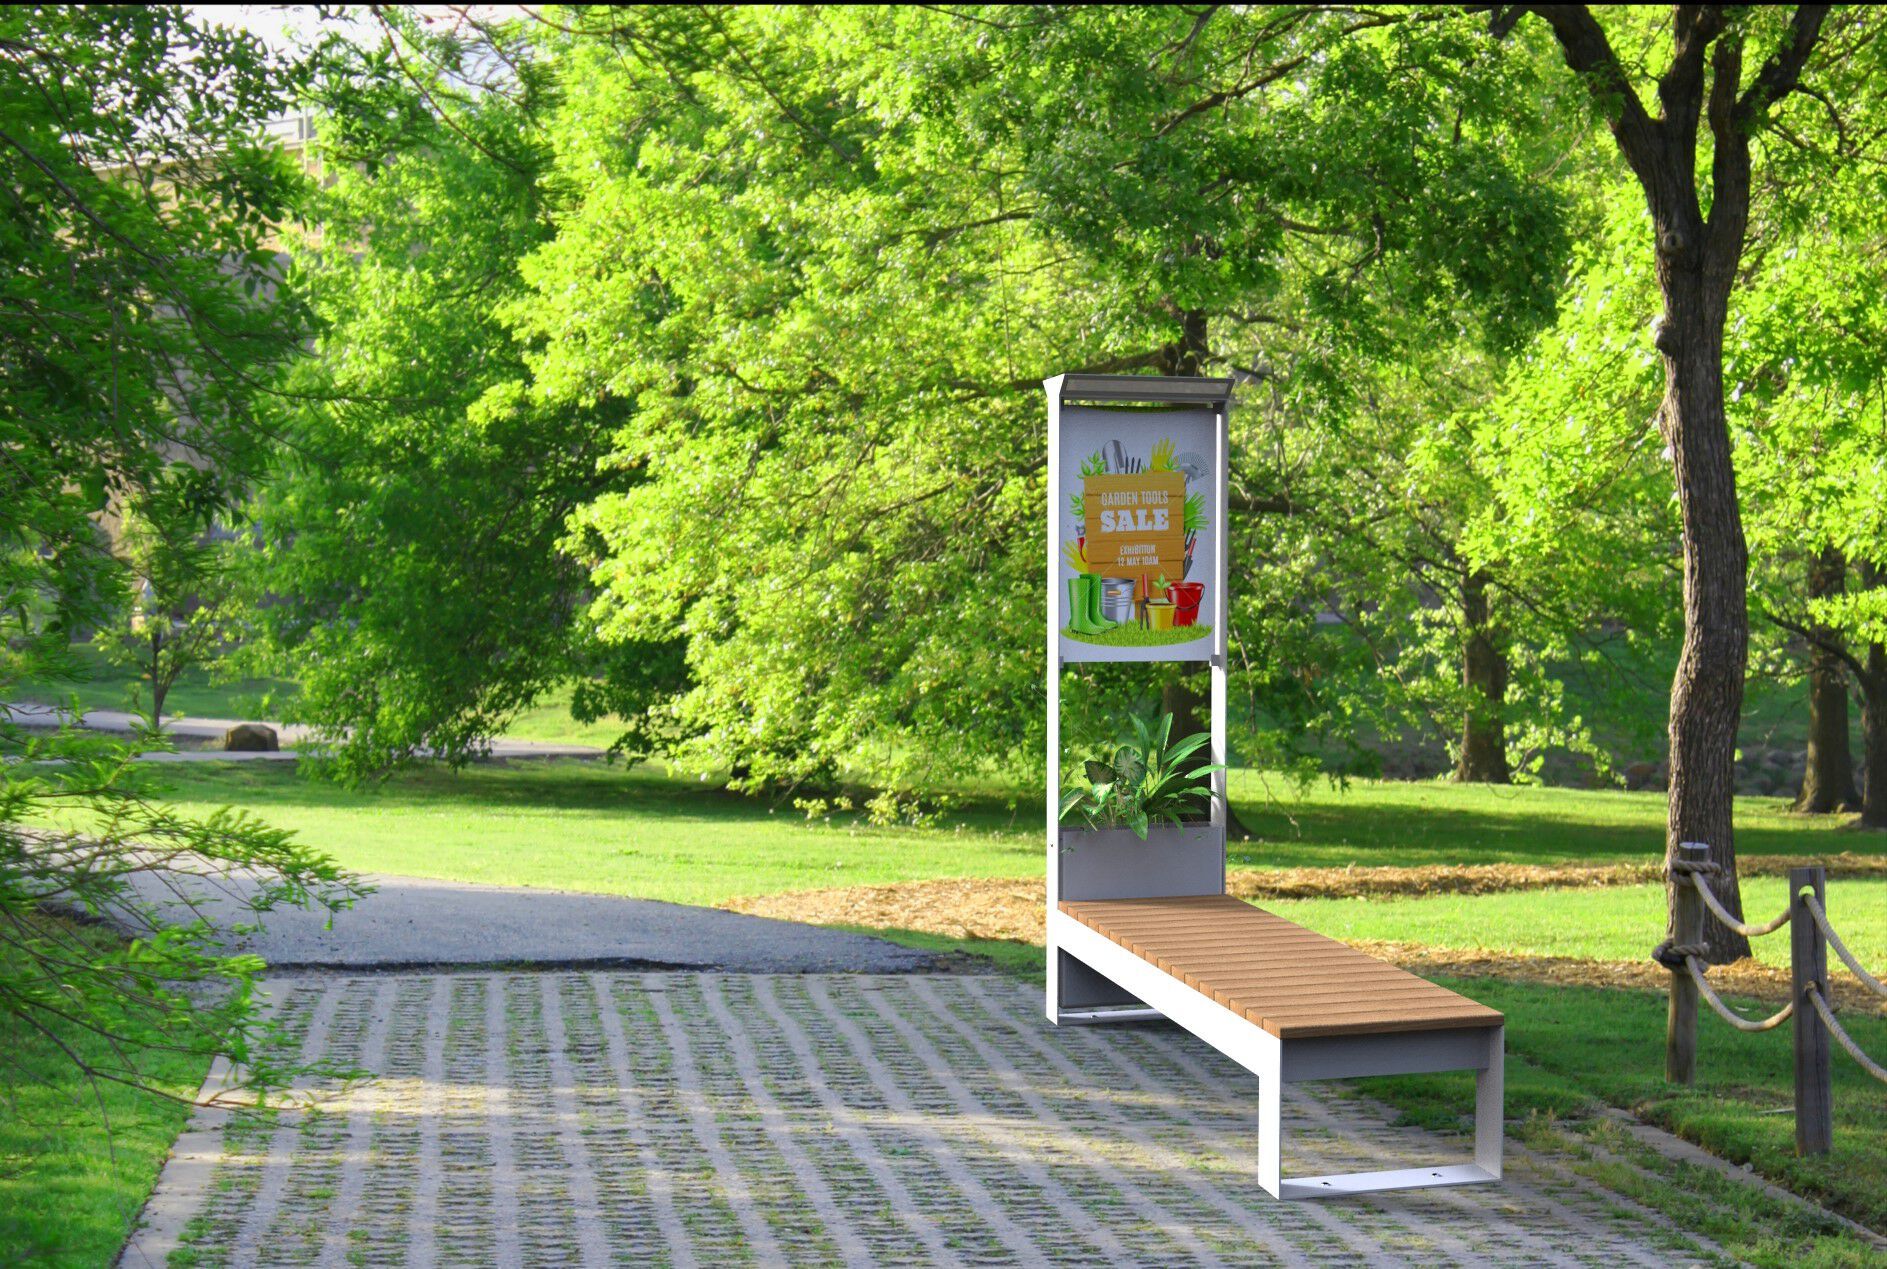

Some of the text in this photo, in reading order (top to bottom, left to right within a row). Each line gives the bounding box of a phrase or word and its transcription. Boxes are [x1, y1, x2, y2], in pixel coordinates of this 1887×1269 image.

[1102, 490, 1168, 506] GARDEN TOOLS
[1100, 508, 1169, 533] SALE
[1118, 555, 1159, 567] 12 MAY 10AM
